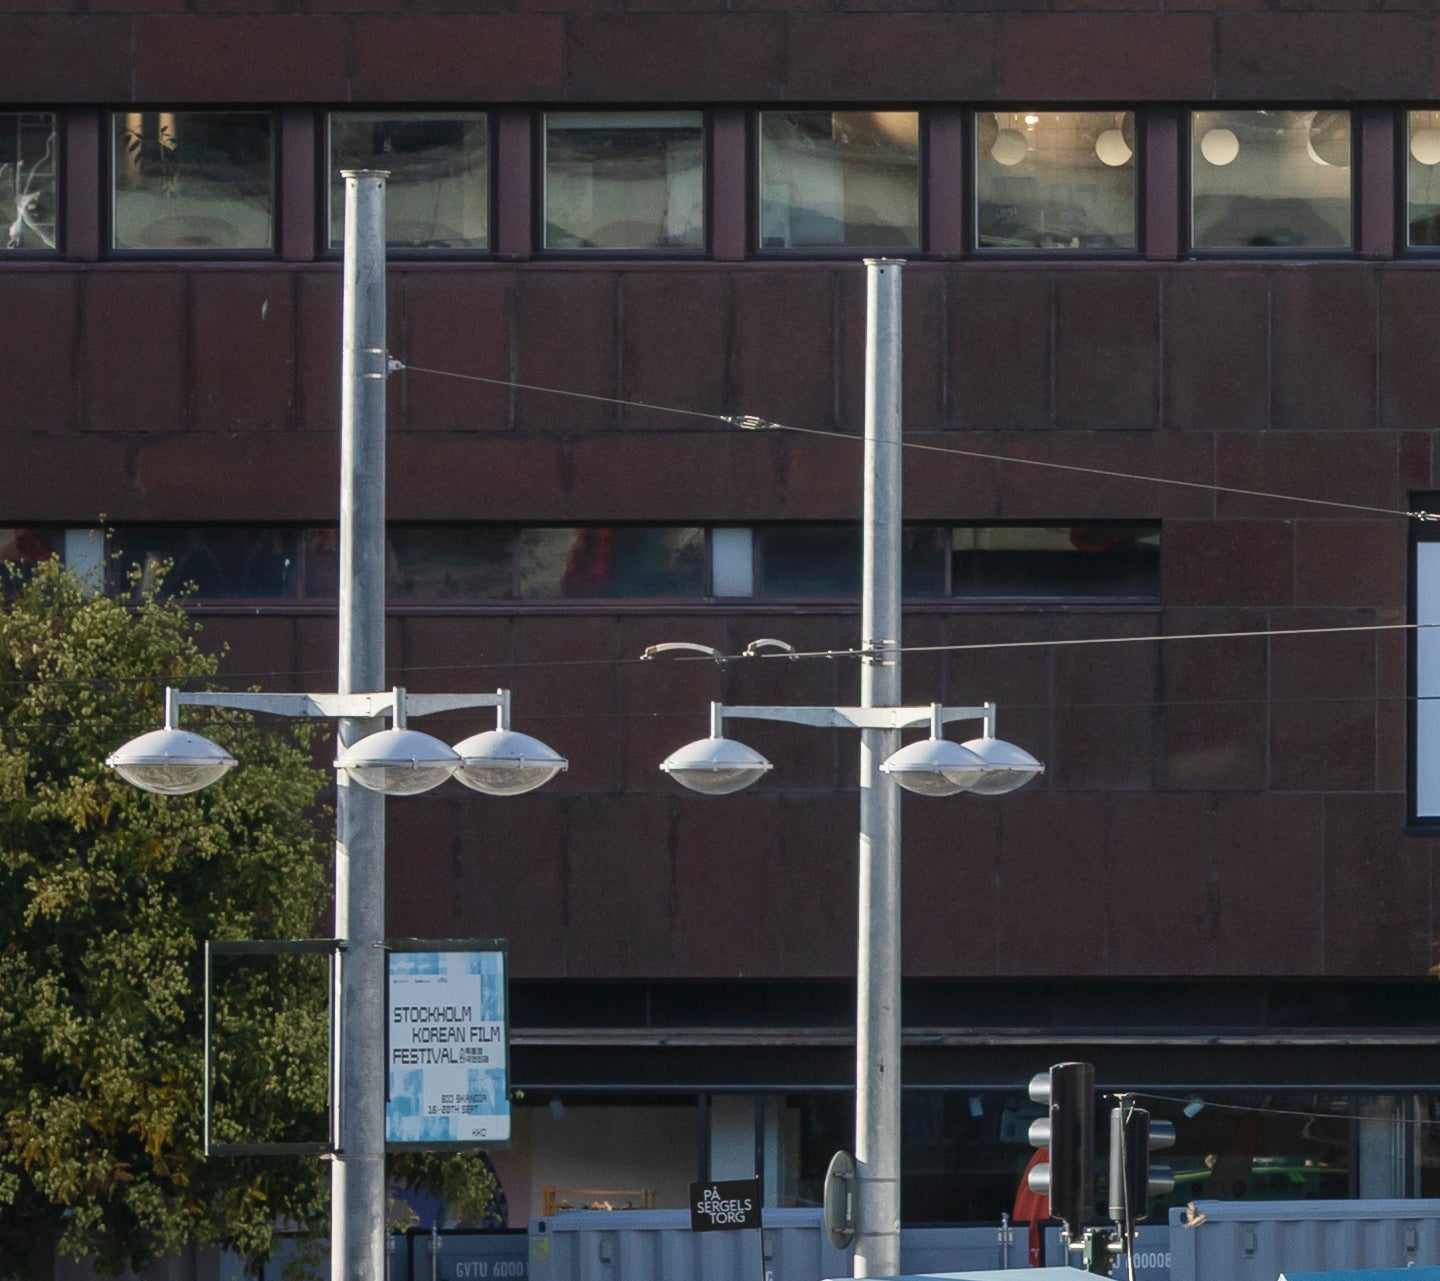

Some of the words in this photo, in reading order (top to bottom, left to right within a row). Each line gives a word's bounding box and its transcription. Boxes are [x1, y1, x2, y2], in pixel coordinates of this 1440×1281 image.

[393, 1006, 472, 1023] STOCKHOLM
[412, 1027, 466, 1043] KOREAN
[469, 1026, 502, 1042] FILM
[393, 1047, 459, 1064] FESTIVAL
[703, 1186, 721, 1201] PÅ
[696, 1198, 752, 1214] SERGELS
[710, 1211, 746, 1224] TORG
[456, 1262, 488, 1278] GVTU
[493, 1261, 529, 1277] 6000
